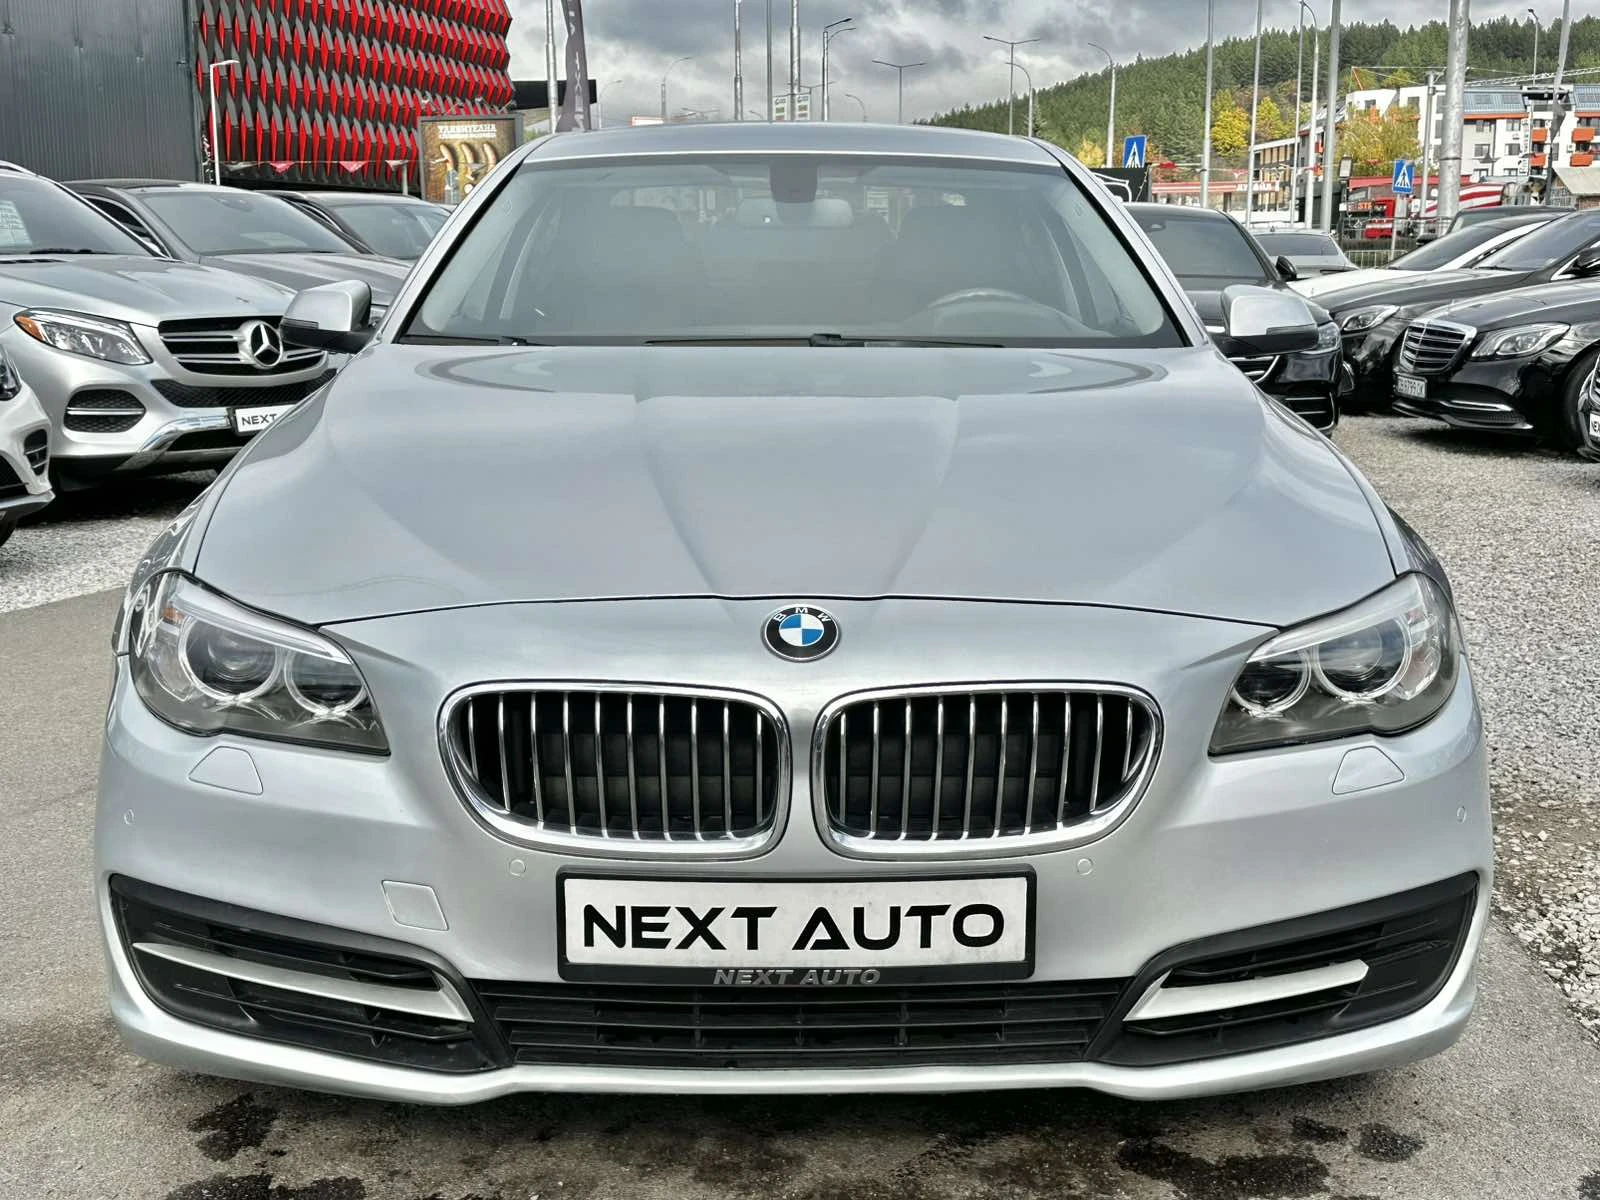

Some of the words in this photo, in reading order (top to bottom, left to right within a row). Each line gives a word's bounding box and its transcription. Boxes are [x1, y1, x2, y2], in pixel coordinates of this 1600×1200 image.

[241, 413, 277, 426] NEXT
[773, 607, 832, 622] BMW
[583, 903, 778, 950] NEXT
[792, 903, 1005, 950] AUTO
[713, 969, 794, 985] NEXT
[799, 969, 881, 985] AUTO
